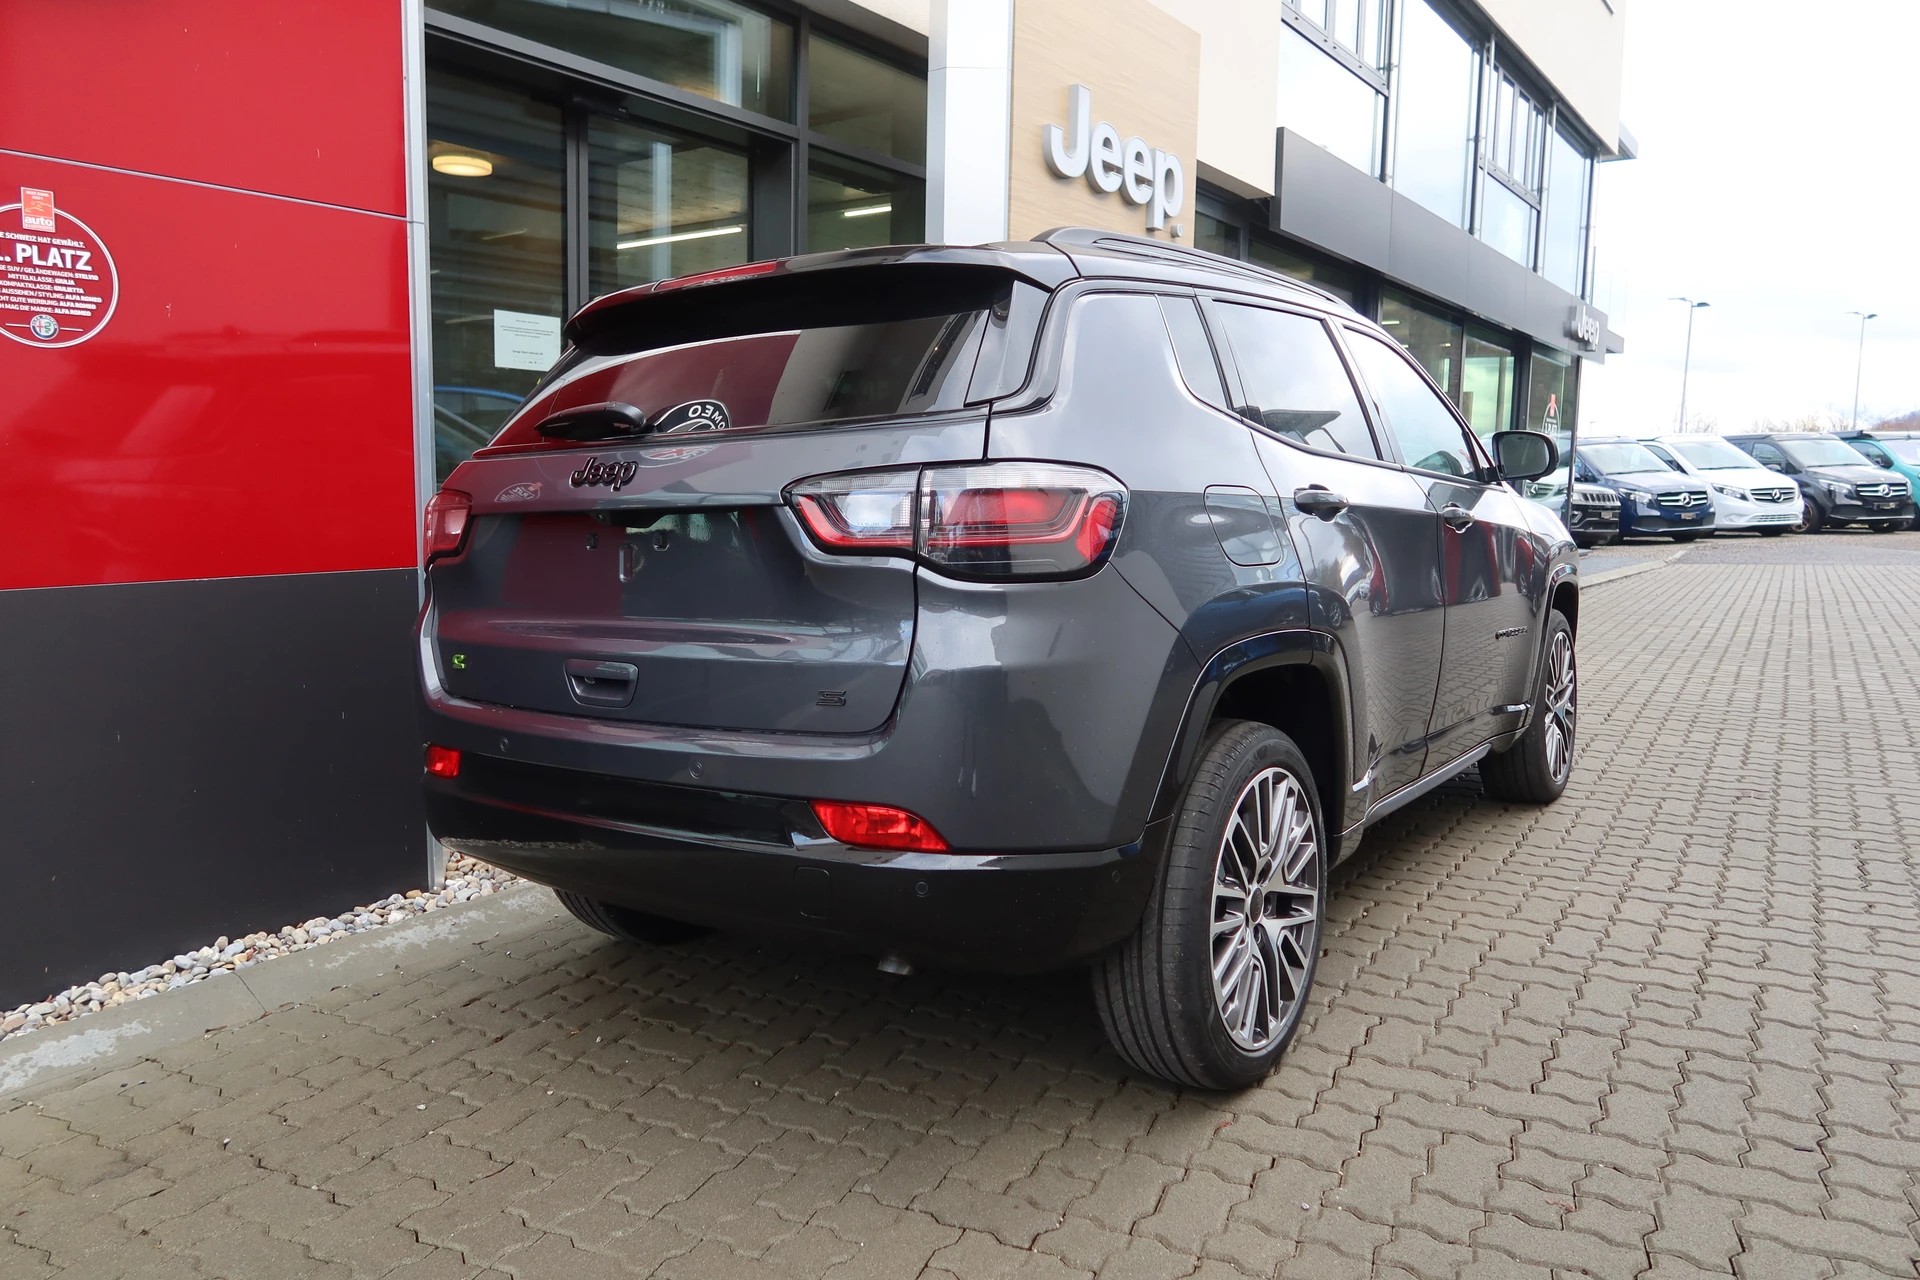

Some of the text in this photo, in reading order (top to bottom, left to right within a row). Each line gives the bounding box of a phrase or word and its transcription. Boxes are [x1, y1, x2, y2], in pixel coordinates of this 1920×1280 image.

[1042, 83, 1184, 231] Jeep
[24, 216, 53, 227] auto
[5, 232, 37, 242] SCHWEIZ
[37, 235, 51, 244] HAT
[52, 238, 86, 248] GEWÄHLT.
[16, 243, 93, 271] PLATZ
[8, 273, 76, 286] MITTELKLASSE: GIULIA
[2, 287, 34, 297] AUSSEHEN
[81, 295, 103, 303] ROMEO
[70, 309, 92, 317] ROMEO
[75, 302, 97, 310] ROMEO
[1571, 304, 1600, 352] Jeep
[569, 457, 639, 492] Jeep
